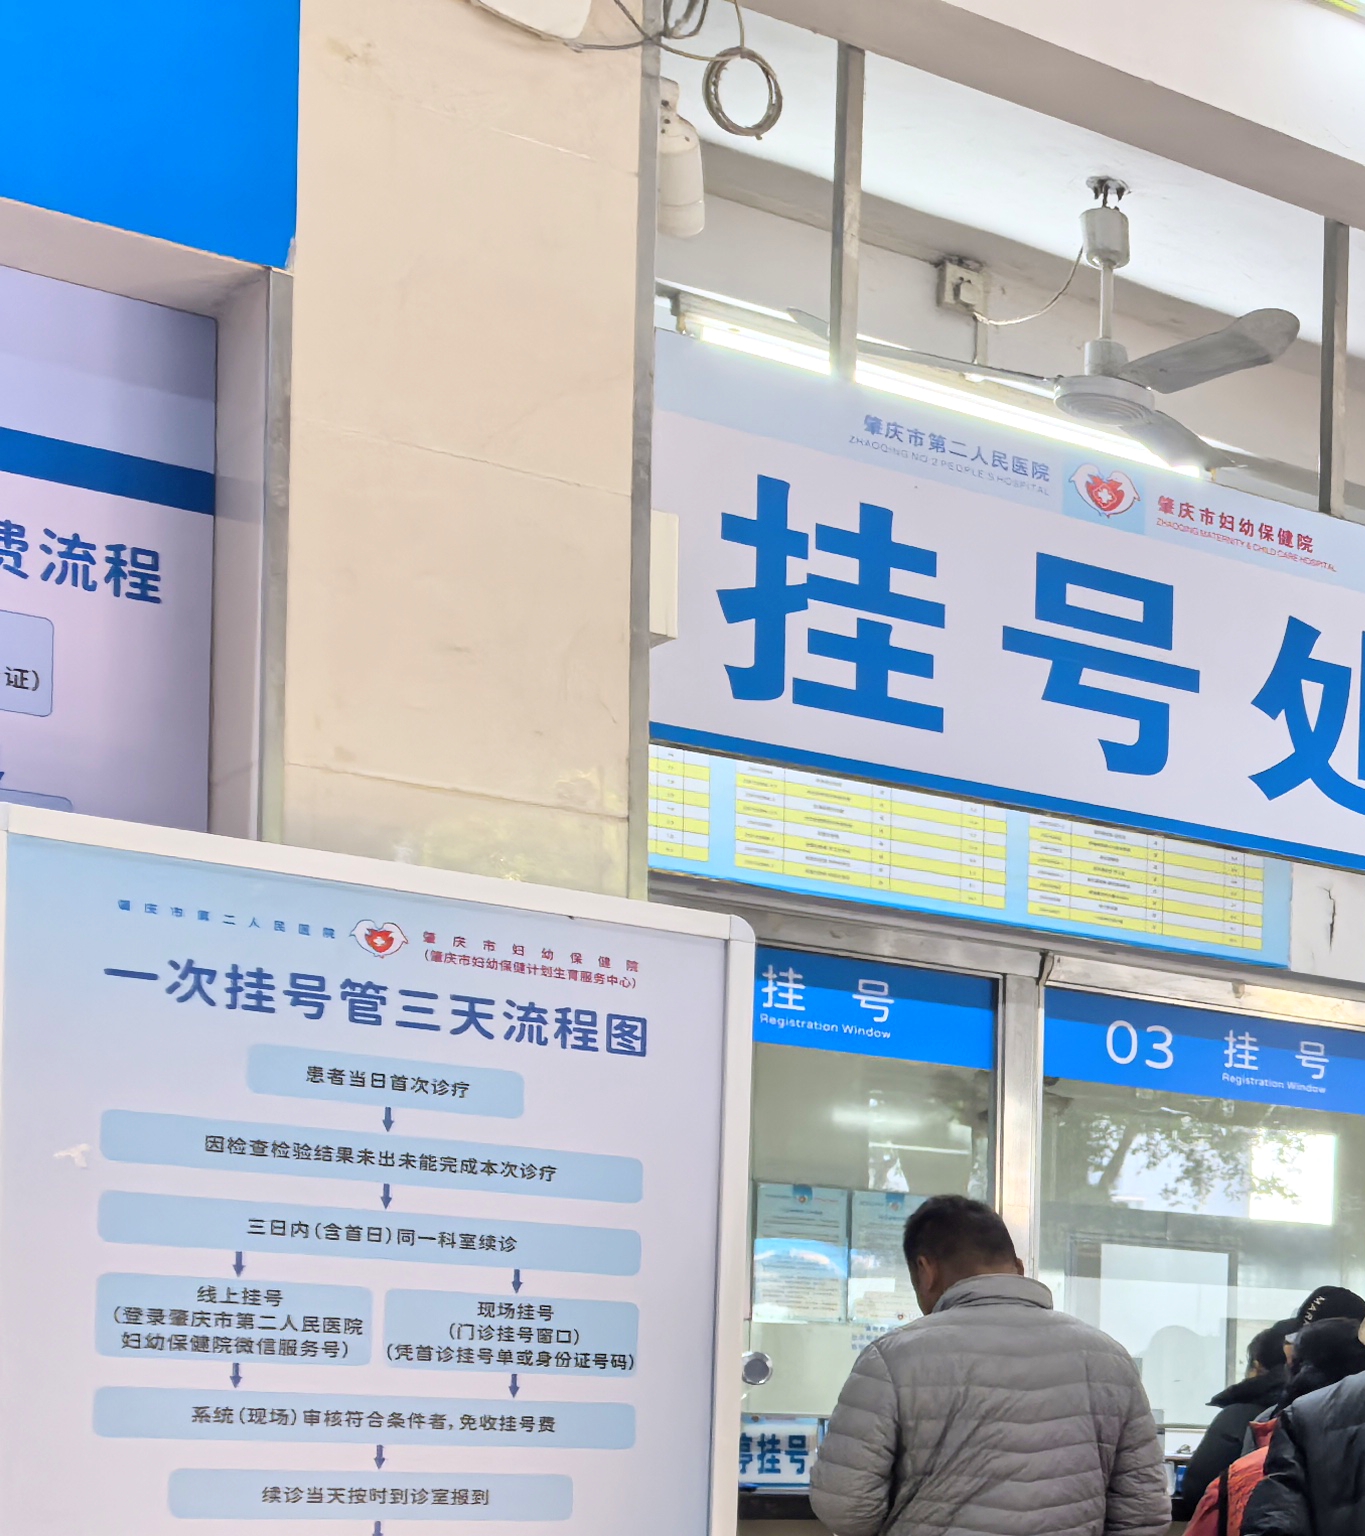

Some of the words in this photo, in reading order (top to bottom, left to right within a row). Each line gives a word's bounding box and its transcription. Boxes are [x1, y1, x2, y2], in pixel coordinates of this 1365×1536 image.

[863, 414, 1050, 482] 肇庆市第二人民医院
[1158, 495, 1314, 553] 肇庆市妇幼保健院
[422, 930, 639, 972] 肇庆市妇幼保健院
[423, 949, 637, 989] （肇庆市妇幼保健计划生育服务中心）
[103, 957, 648, 1058] 一次挂号管三天流程图
[761, 964, 895, 1023] 挂号
[759, 1012, 839, 1034] Registration
[842, 1023, 892, 1040] Window
[1105, 1019, 1174, 1070] 03
[1223, 1029, 1330, 1080] 挂号
[305, 1064, 470, 1100] 患者当日首次诊疗
[1222, 1072, 1284, 1089] Registration
[1286, 1079, 1328, 1094] Window
[205, 1134, 556, 1182] 因检查检验结果未出未能完成本次诊疗
[247, 1217, 518, 1254] 三日内（含首日）同一科室续诊
[197, 1286, 283, 1307] 线上挂号
[477, 1301, 555, 1322] 现场挂号
[113, 1305, 364, 1338] （登录肇庆市第二人民医院
[448, 1323, 580, 1347] （门诊挂号窗口）
[120, 1332, 349, 1361] 妇幼保健院微信服务号）
[386, 1344, 635, 1372] （凭首诊挂号单或身份证号码）
[191, 1404, 557, 1434] 系统（现场）审核符合条件者，免收挂号费
[261, 1486, 490, 1507] 续诊当天按时到诊室报到
